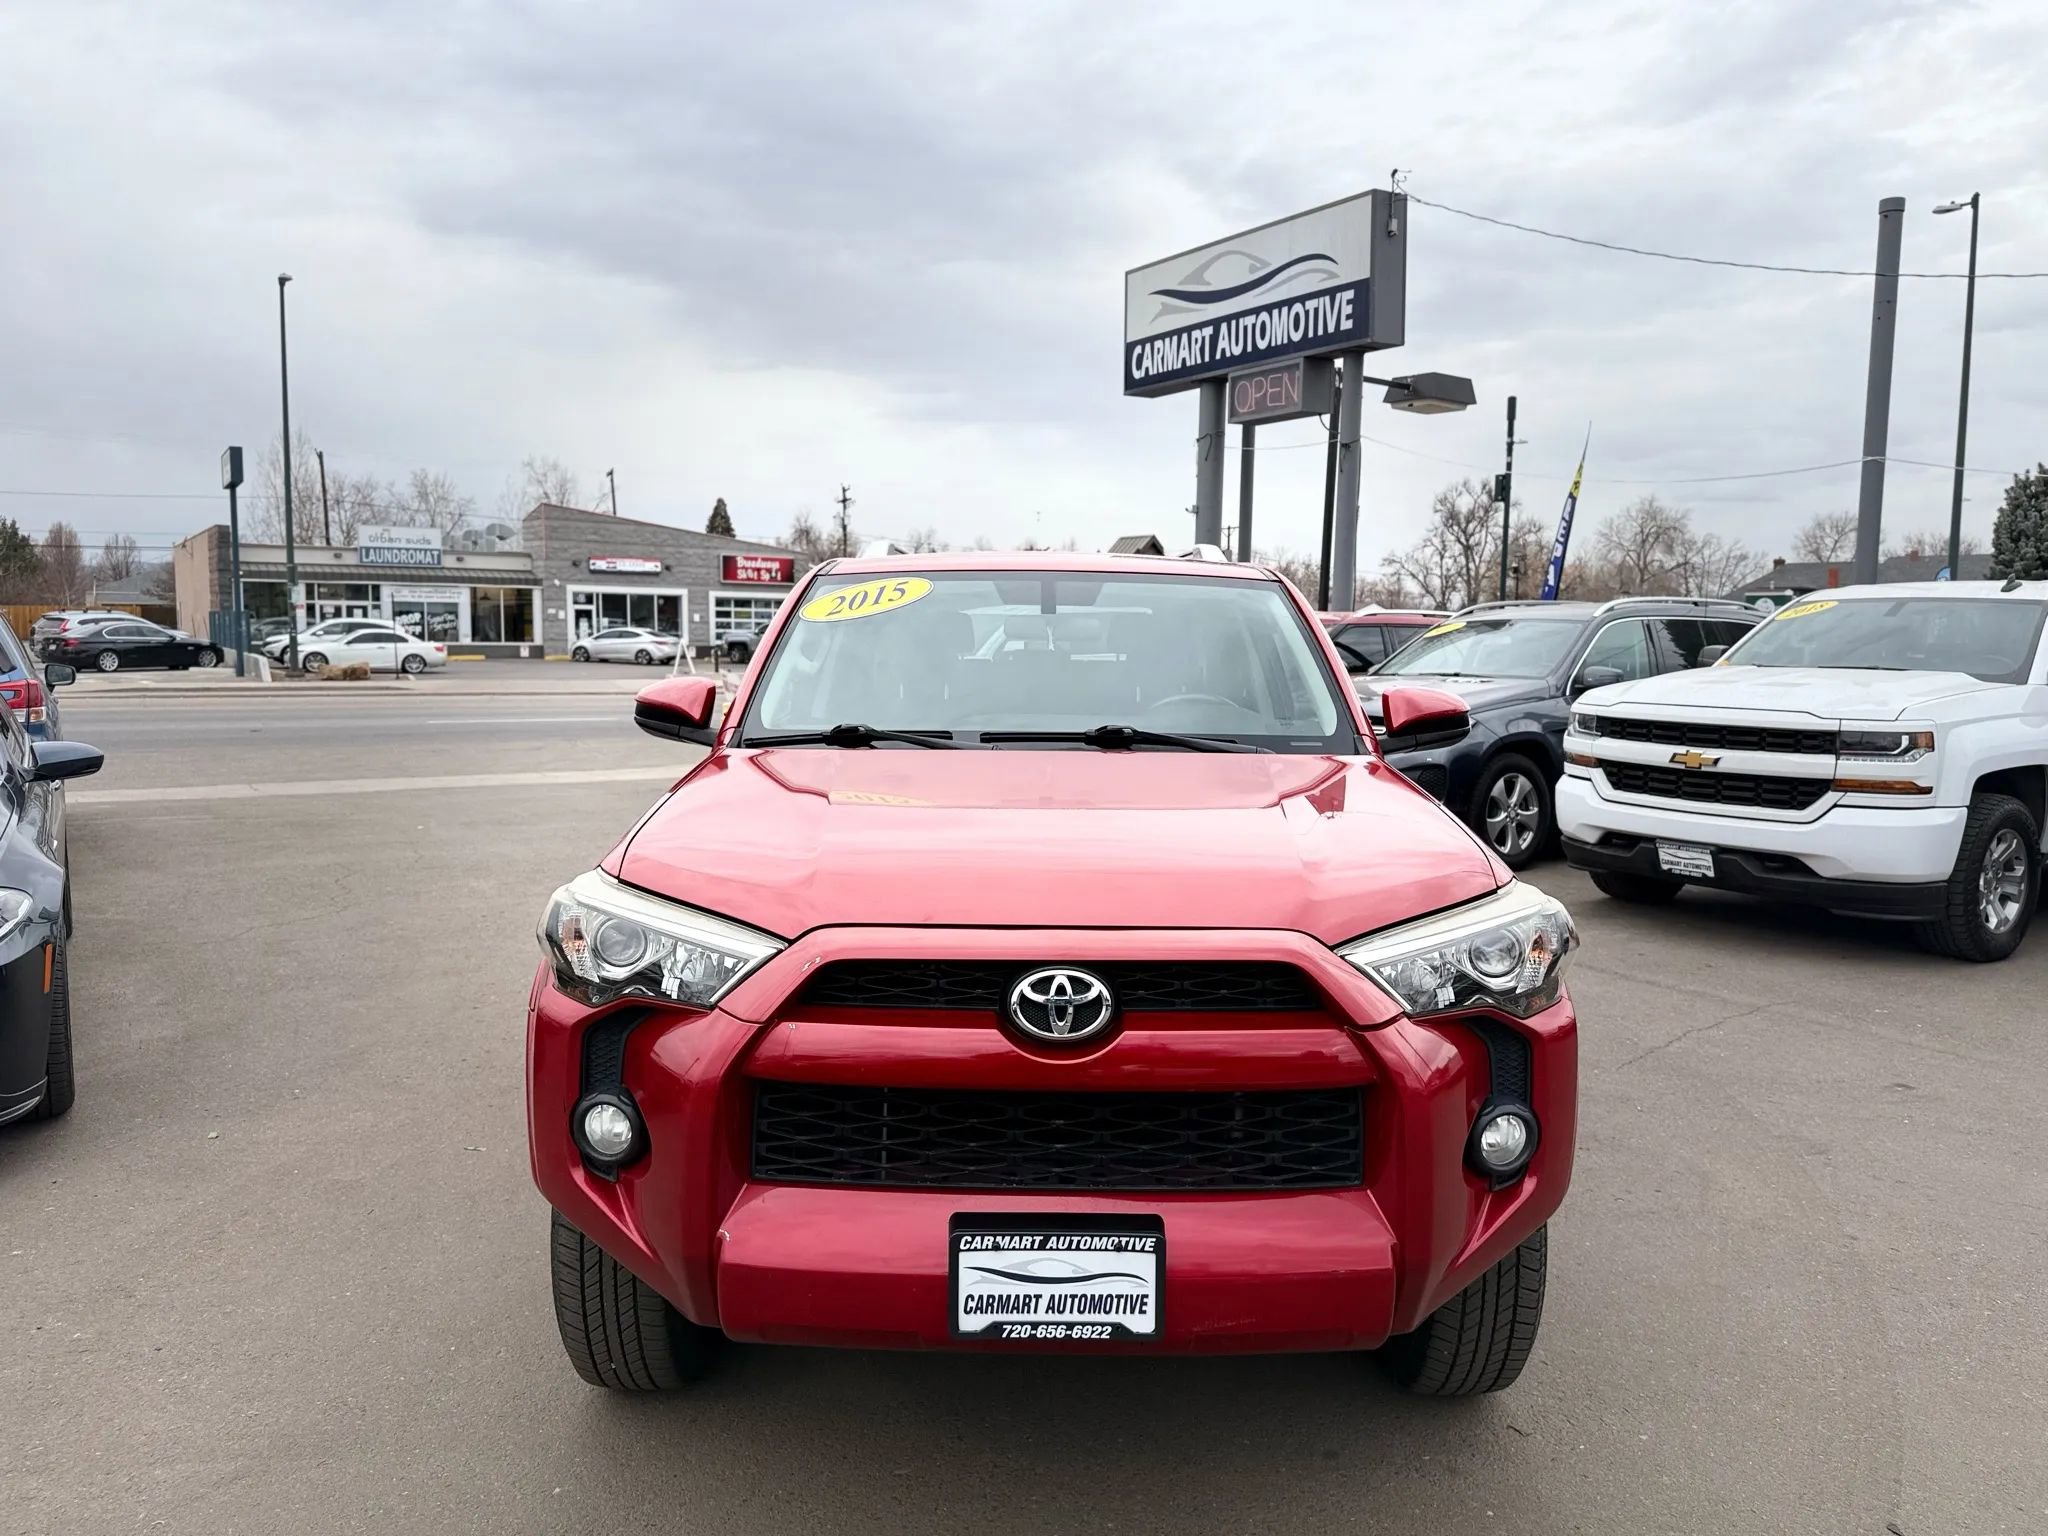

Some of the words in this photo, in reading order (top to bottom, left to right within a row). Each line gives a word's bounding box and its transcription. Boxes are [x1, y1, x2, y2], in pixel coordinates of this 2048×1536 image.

[1131, 325, 1213, 380] CARMART
[1215, 289, 1355, 360] AUTOMOTIVE
[1234, 370, 1299, 413] OPEN
[361, 548, 439, 565] LAUNDROMAT
[825, 581, 909, 617] 2015
[1661, 858, 1682, 867] CARMART
[1683, 861, 1712, 872] AUTOMOTIVE
[959, 1235, 1043, 1250] CARMART
[1046, 1236, 1156, 1251] AUTOMOTIVE
[963, 1293, 1043, 1315] CARMART
[1045, 1293, 1150, 1315] AUTOMOTIVE
[1001, 1324, 1113, 1339] 720-656-6922
